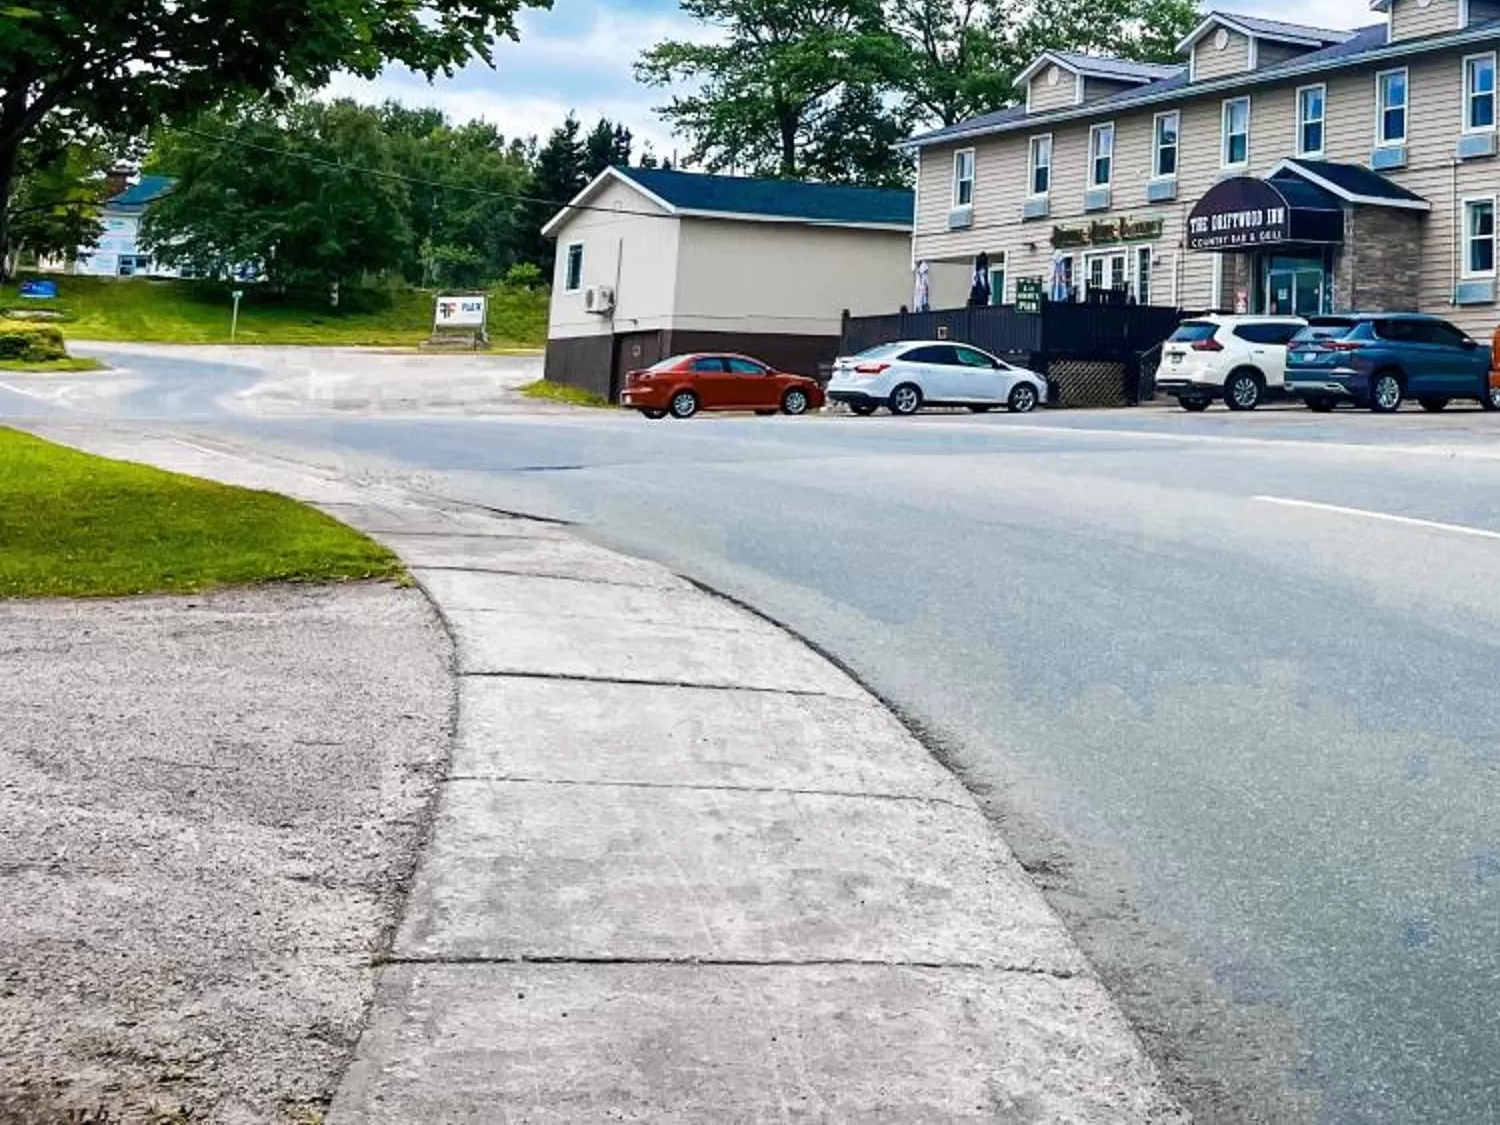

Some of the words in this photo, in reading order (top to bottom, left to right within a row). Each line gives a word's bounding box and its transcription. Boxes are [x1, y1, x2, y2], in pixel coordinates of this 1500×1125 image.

[1190, 216, 1209, 233] THE
[1211, 209, 1263, 231] DRIFTWOOD
[1267, 207, 1285, 225] INN
[1191, 236, 1228, 247] COUNTRY
